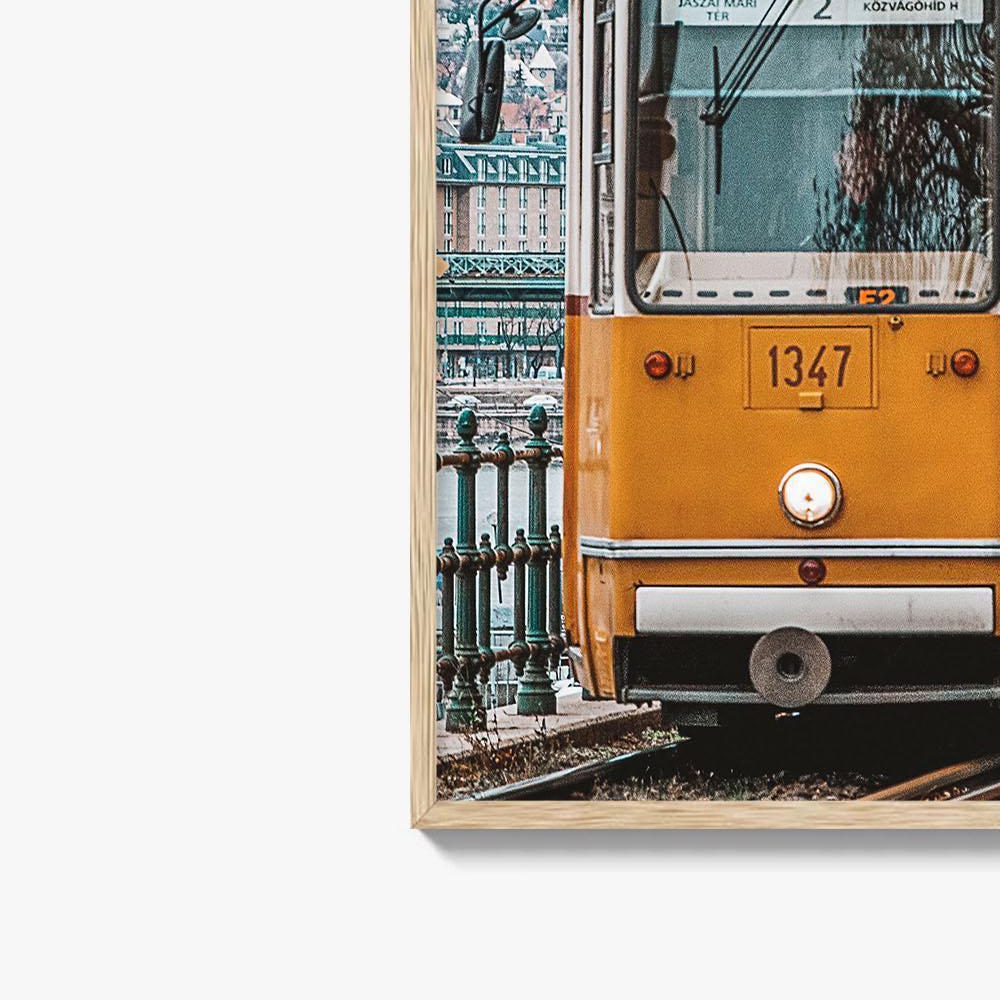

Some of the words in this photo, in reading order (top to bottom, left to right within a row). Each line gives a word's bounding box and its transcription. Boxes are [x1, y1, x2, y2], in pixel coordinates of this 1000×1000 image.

[950, 1, 959, 10] H
[706, 9, 729, 21] TÉR
[769, 344, 852, 388] 1347
